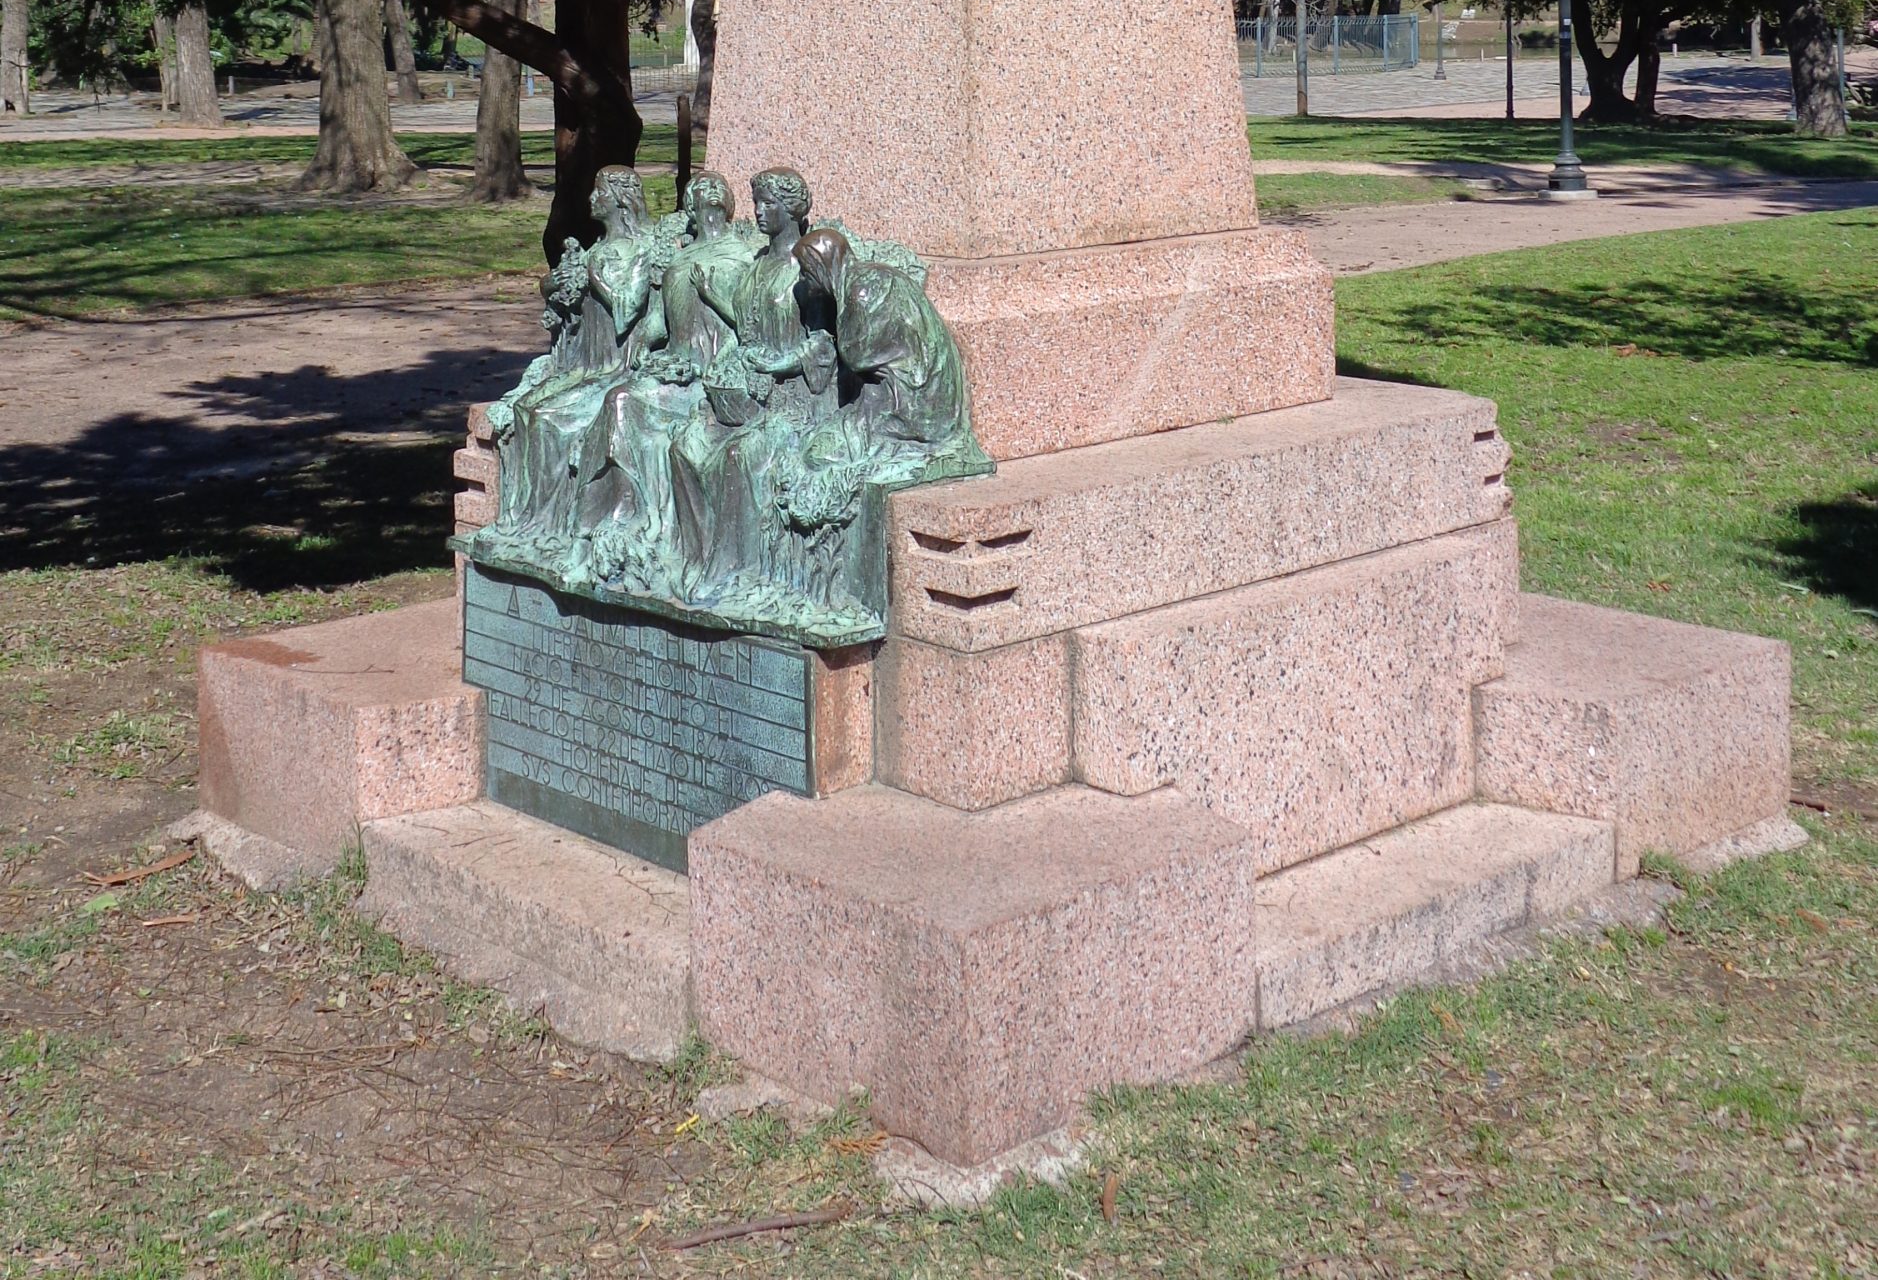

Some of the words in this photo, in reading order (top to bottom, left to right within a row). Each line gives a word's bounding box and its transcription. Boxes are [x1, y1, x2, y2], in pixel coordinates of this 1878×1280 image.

[513, 645, 562, 683] NACIO
[571, 663, 590, 693] EN
[600, 671, 707, 730] MONTEVIDEO
[718, 707, 742, 741] EL
[532, 624, 604, 667] LITERATO
[624, 650, 718, 706] PERIODISTA
[487, 688, 569, 737] FALLECIO
[573, 716, 592, 749] EL
[597, 726, 617, 757] 22
[621, 733, 639, 766] DE
[644, 740, 689, 778] MAYO
[694, 756, 716, 792] DE
[523, 677, 541, 705] 29
[552, 684, 571, 715] DE
[582, 698, 655, 739] AGOSTO
[661, 720, 680, 751] DE
[521, 752, 551, 786] SVS
[561, 739, 651, 797] HOMENAJE
[666, 775, 687, 811] DE
